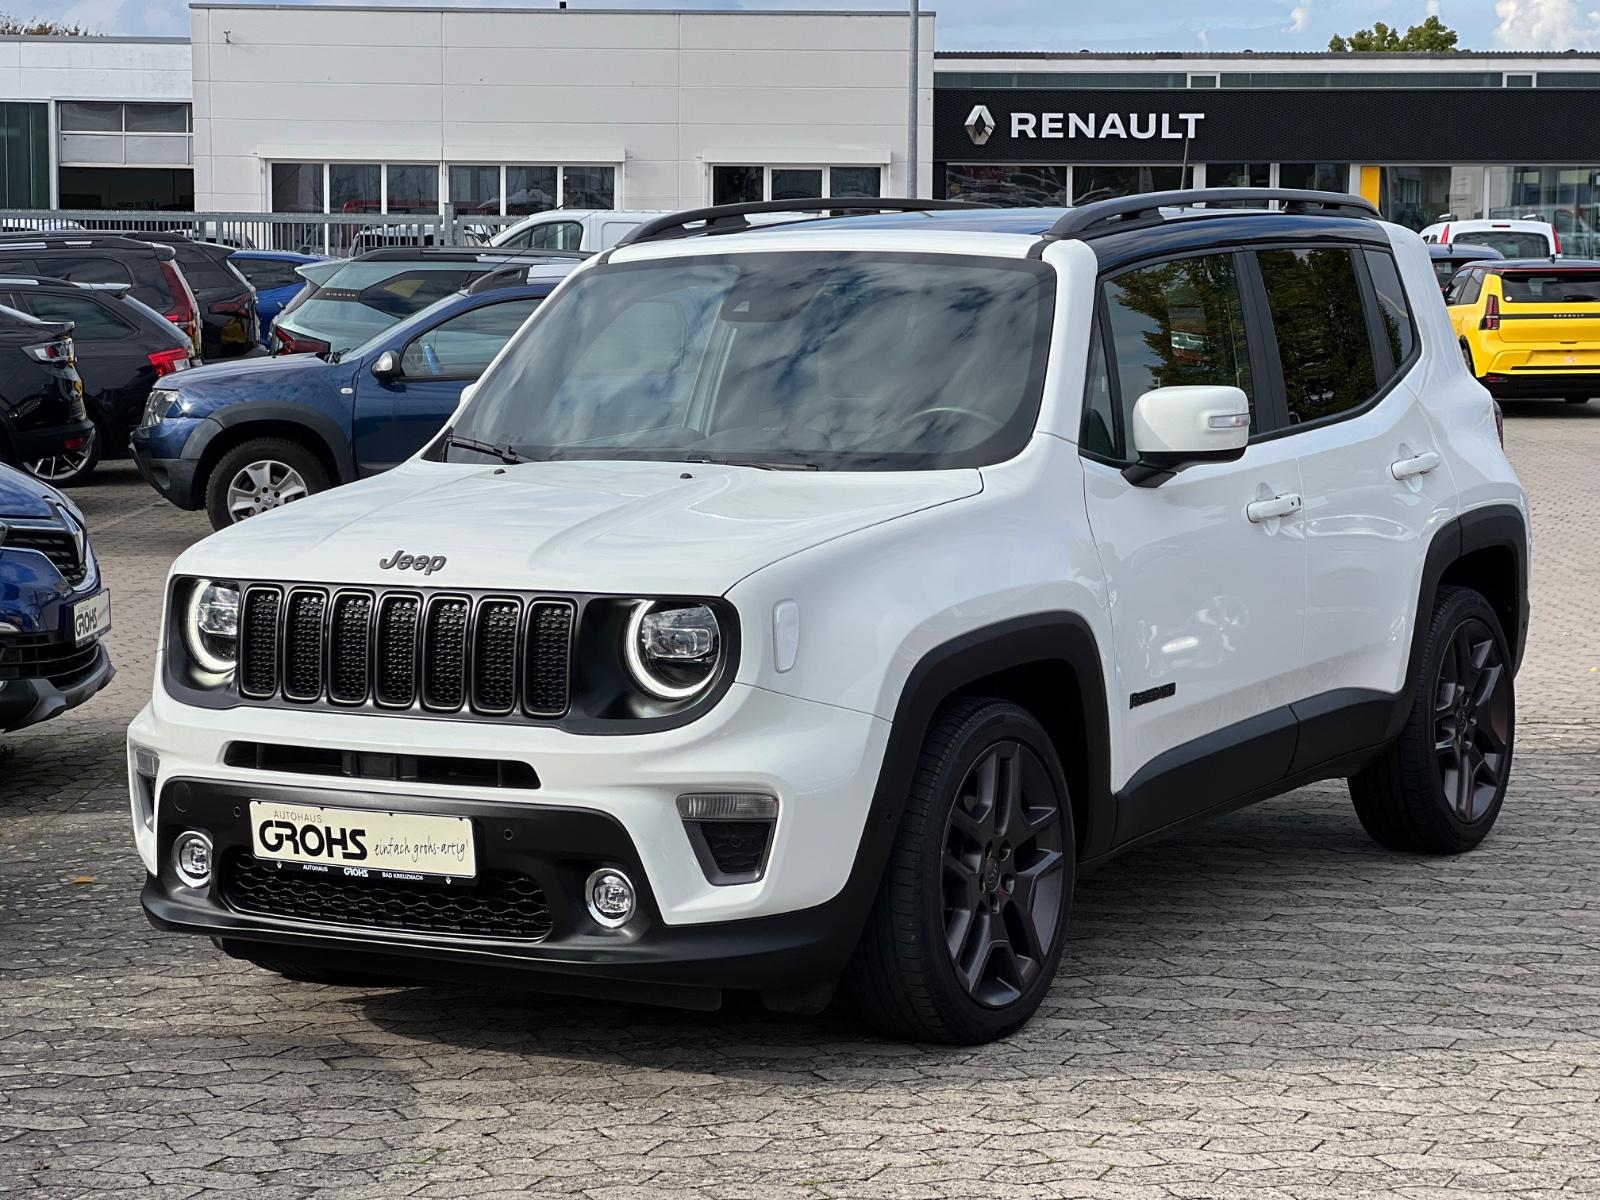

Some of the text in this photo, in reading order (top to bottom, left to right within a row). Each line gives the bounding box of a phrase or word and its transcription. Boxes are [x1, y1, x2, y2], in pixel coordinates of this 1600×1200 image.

[1010, 112, 1205, 139] RENAULT
[379, 550, 447, 576] Jeep
[273, 810, 323, 824] AUTOHAUS
[259, 819, 368, 861] GROHS
[374, 835, 410, 856] einfach
[302, 864, 329, 872] AUTOHAUS
[343, 867, 369, 878] GROHS
[393, 873, 424, 881] KREUZNACH
